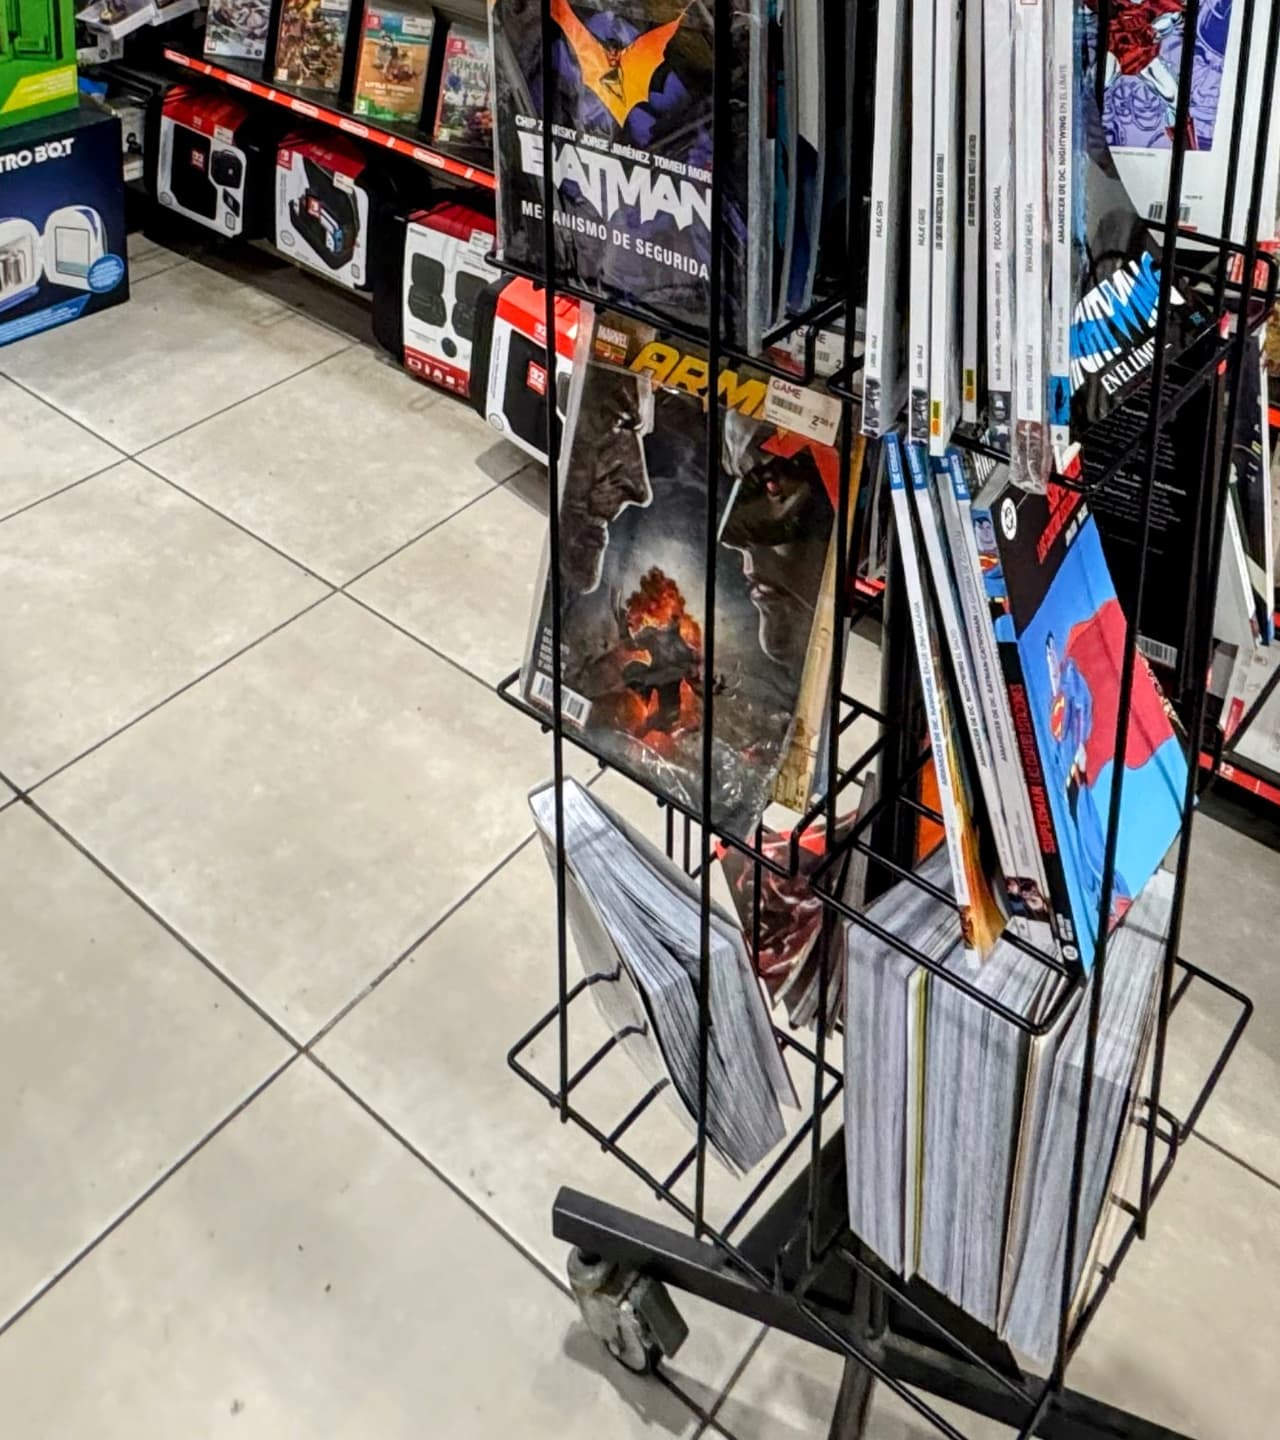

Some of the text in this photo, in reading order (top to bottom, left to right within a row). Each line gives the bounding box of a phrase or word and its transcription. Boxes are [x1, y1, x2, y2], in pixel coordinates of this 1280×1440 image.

[25, 136, 74, 162] BOT
[515, 115, 686, 175] CHIP JORGE JIMÉNEZ TOMEU
[517, 131, 712, 232] BATMAN
[1057, 196, 1066, 245] AMANECER
[613, 230, 630, 249] DE
[597, 325, 628, 349] MARVEL
[772, 379, 803, 400] GAME
[1101, 362, 1135, 395] EN EL
[1030, 785, 1057, 854] SUPERMAN
